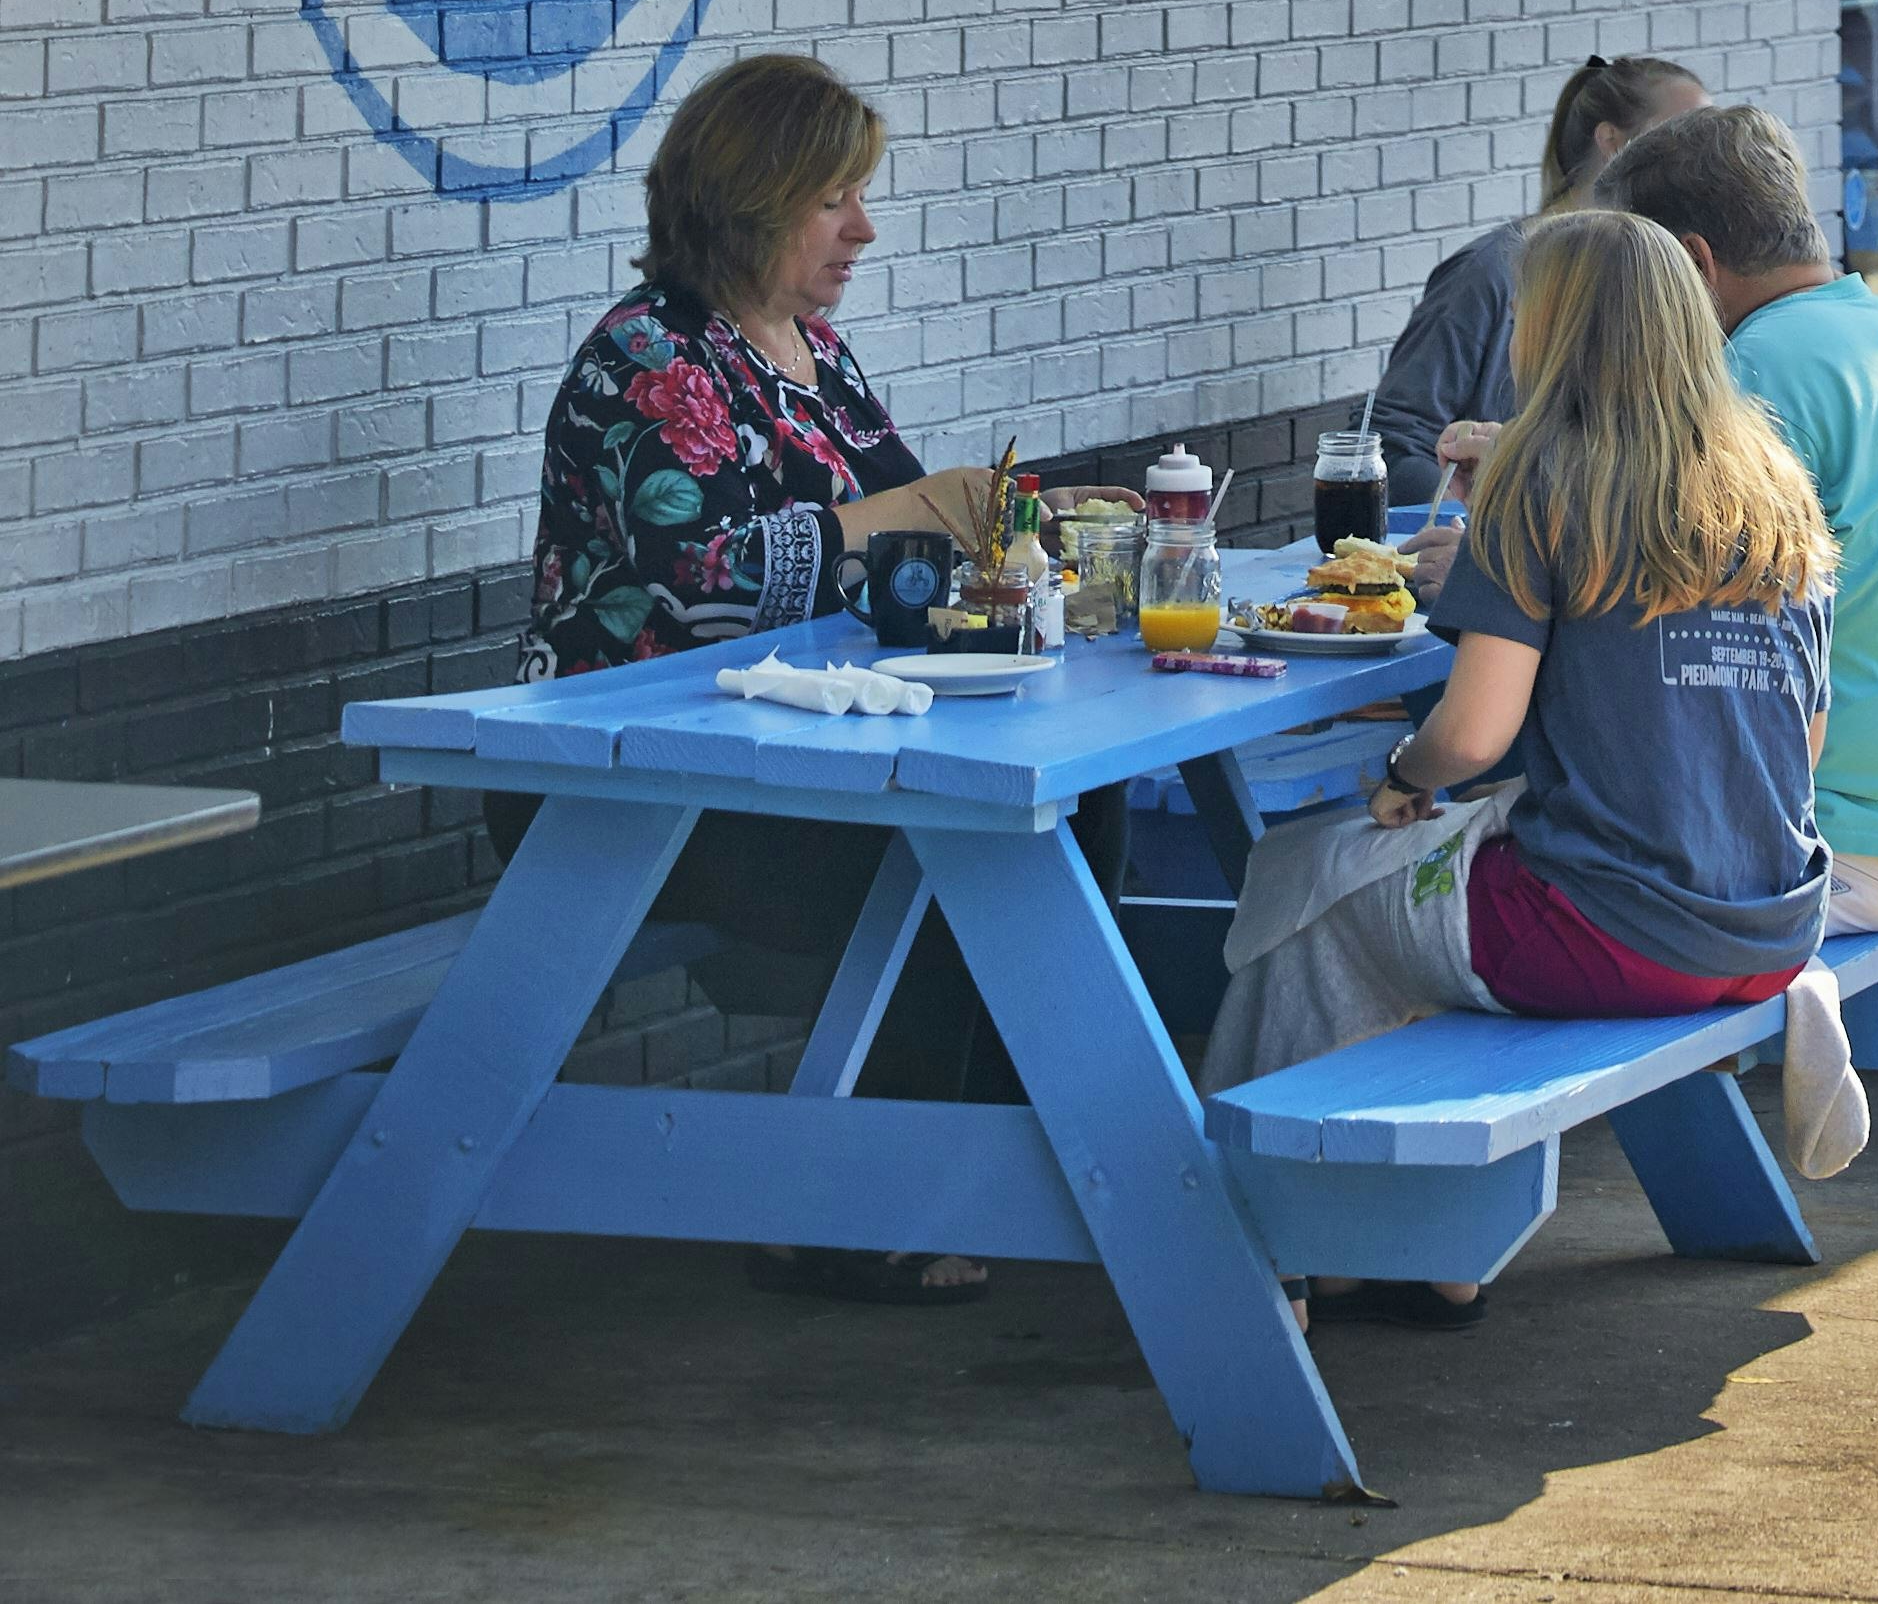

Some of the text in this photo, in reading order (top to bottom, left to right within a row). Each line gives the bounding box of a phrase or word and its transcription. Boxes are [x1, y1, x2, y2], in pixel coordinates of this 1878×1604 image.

[1711, 646, 1757, 665] SEPTEMBER
[1681, 664, 1739, 688] PIEDMONT
[1741, 667, 1770, 692] PARK
